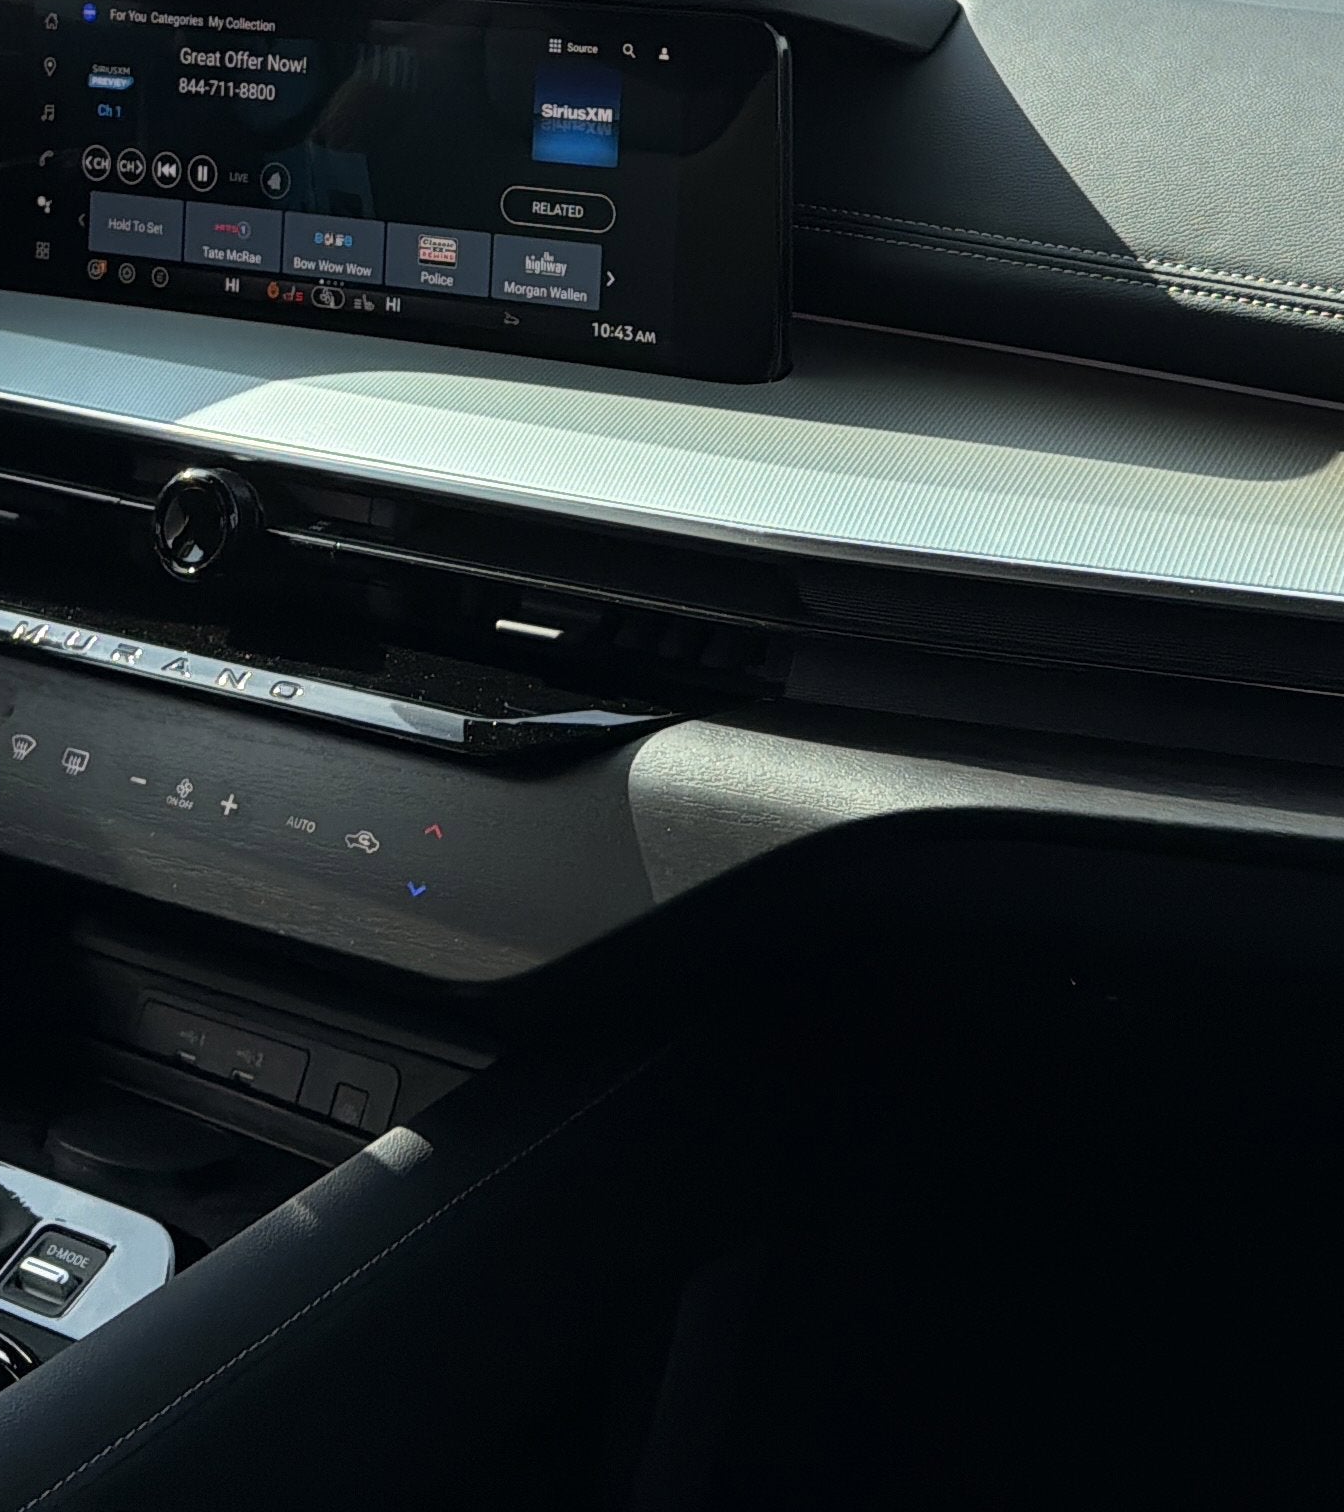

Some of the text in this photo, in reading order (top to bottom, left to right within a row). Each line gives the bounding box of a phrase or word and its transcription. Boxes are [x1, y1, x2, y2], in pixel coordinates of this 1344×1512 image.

[109, 8, 128, 22] For
[128, 10, 147, 23] You
[150, 11, 204, 28] Categories
[208, 16, 224, 31] My
[226, 17, 276, 32] Collection
[567, 42, 599, 55] Source
[180, 47, 307, 74] Great Offer Now!
[179, 77, 276, 101] 844-711-8800
[97, 103, 122, 118] Ch 1
[541, 103, 613, 123] SiriusXM
[229, 172, 249, 183] LIVE
[532, 201, 584, 219] RELATED
[108, 217, 164, 236] Hold To Set
[202, 245, 262, 264] Tate McRae
[543, 251, 554, 262] the
[293, 256, 372, 277] Bow Wow Wow
[525, 255, 567, 277] highway
[225, 277, 240, 293] HI
[420, 271, 454, 286] Police
[504, 281, 587, 303] Morgan Wallen
[385, 296, 401, 313] HI
[592, 322, 656, 344] 10:43 AM
[11, 619, 305, 700] MURANO
[166, 794, 194, 811] ON OFF
[286, 815, 317, 834] AUTO
[46, 1244, 90, 1269] D-MODE
